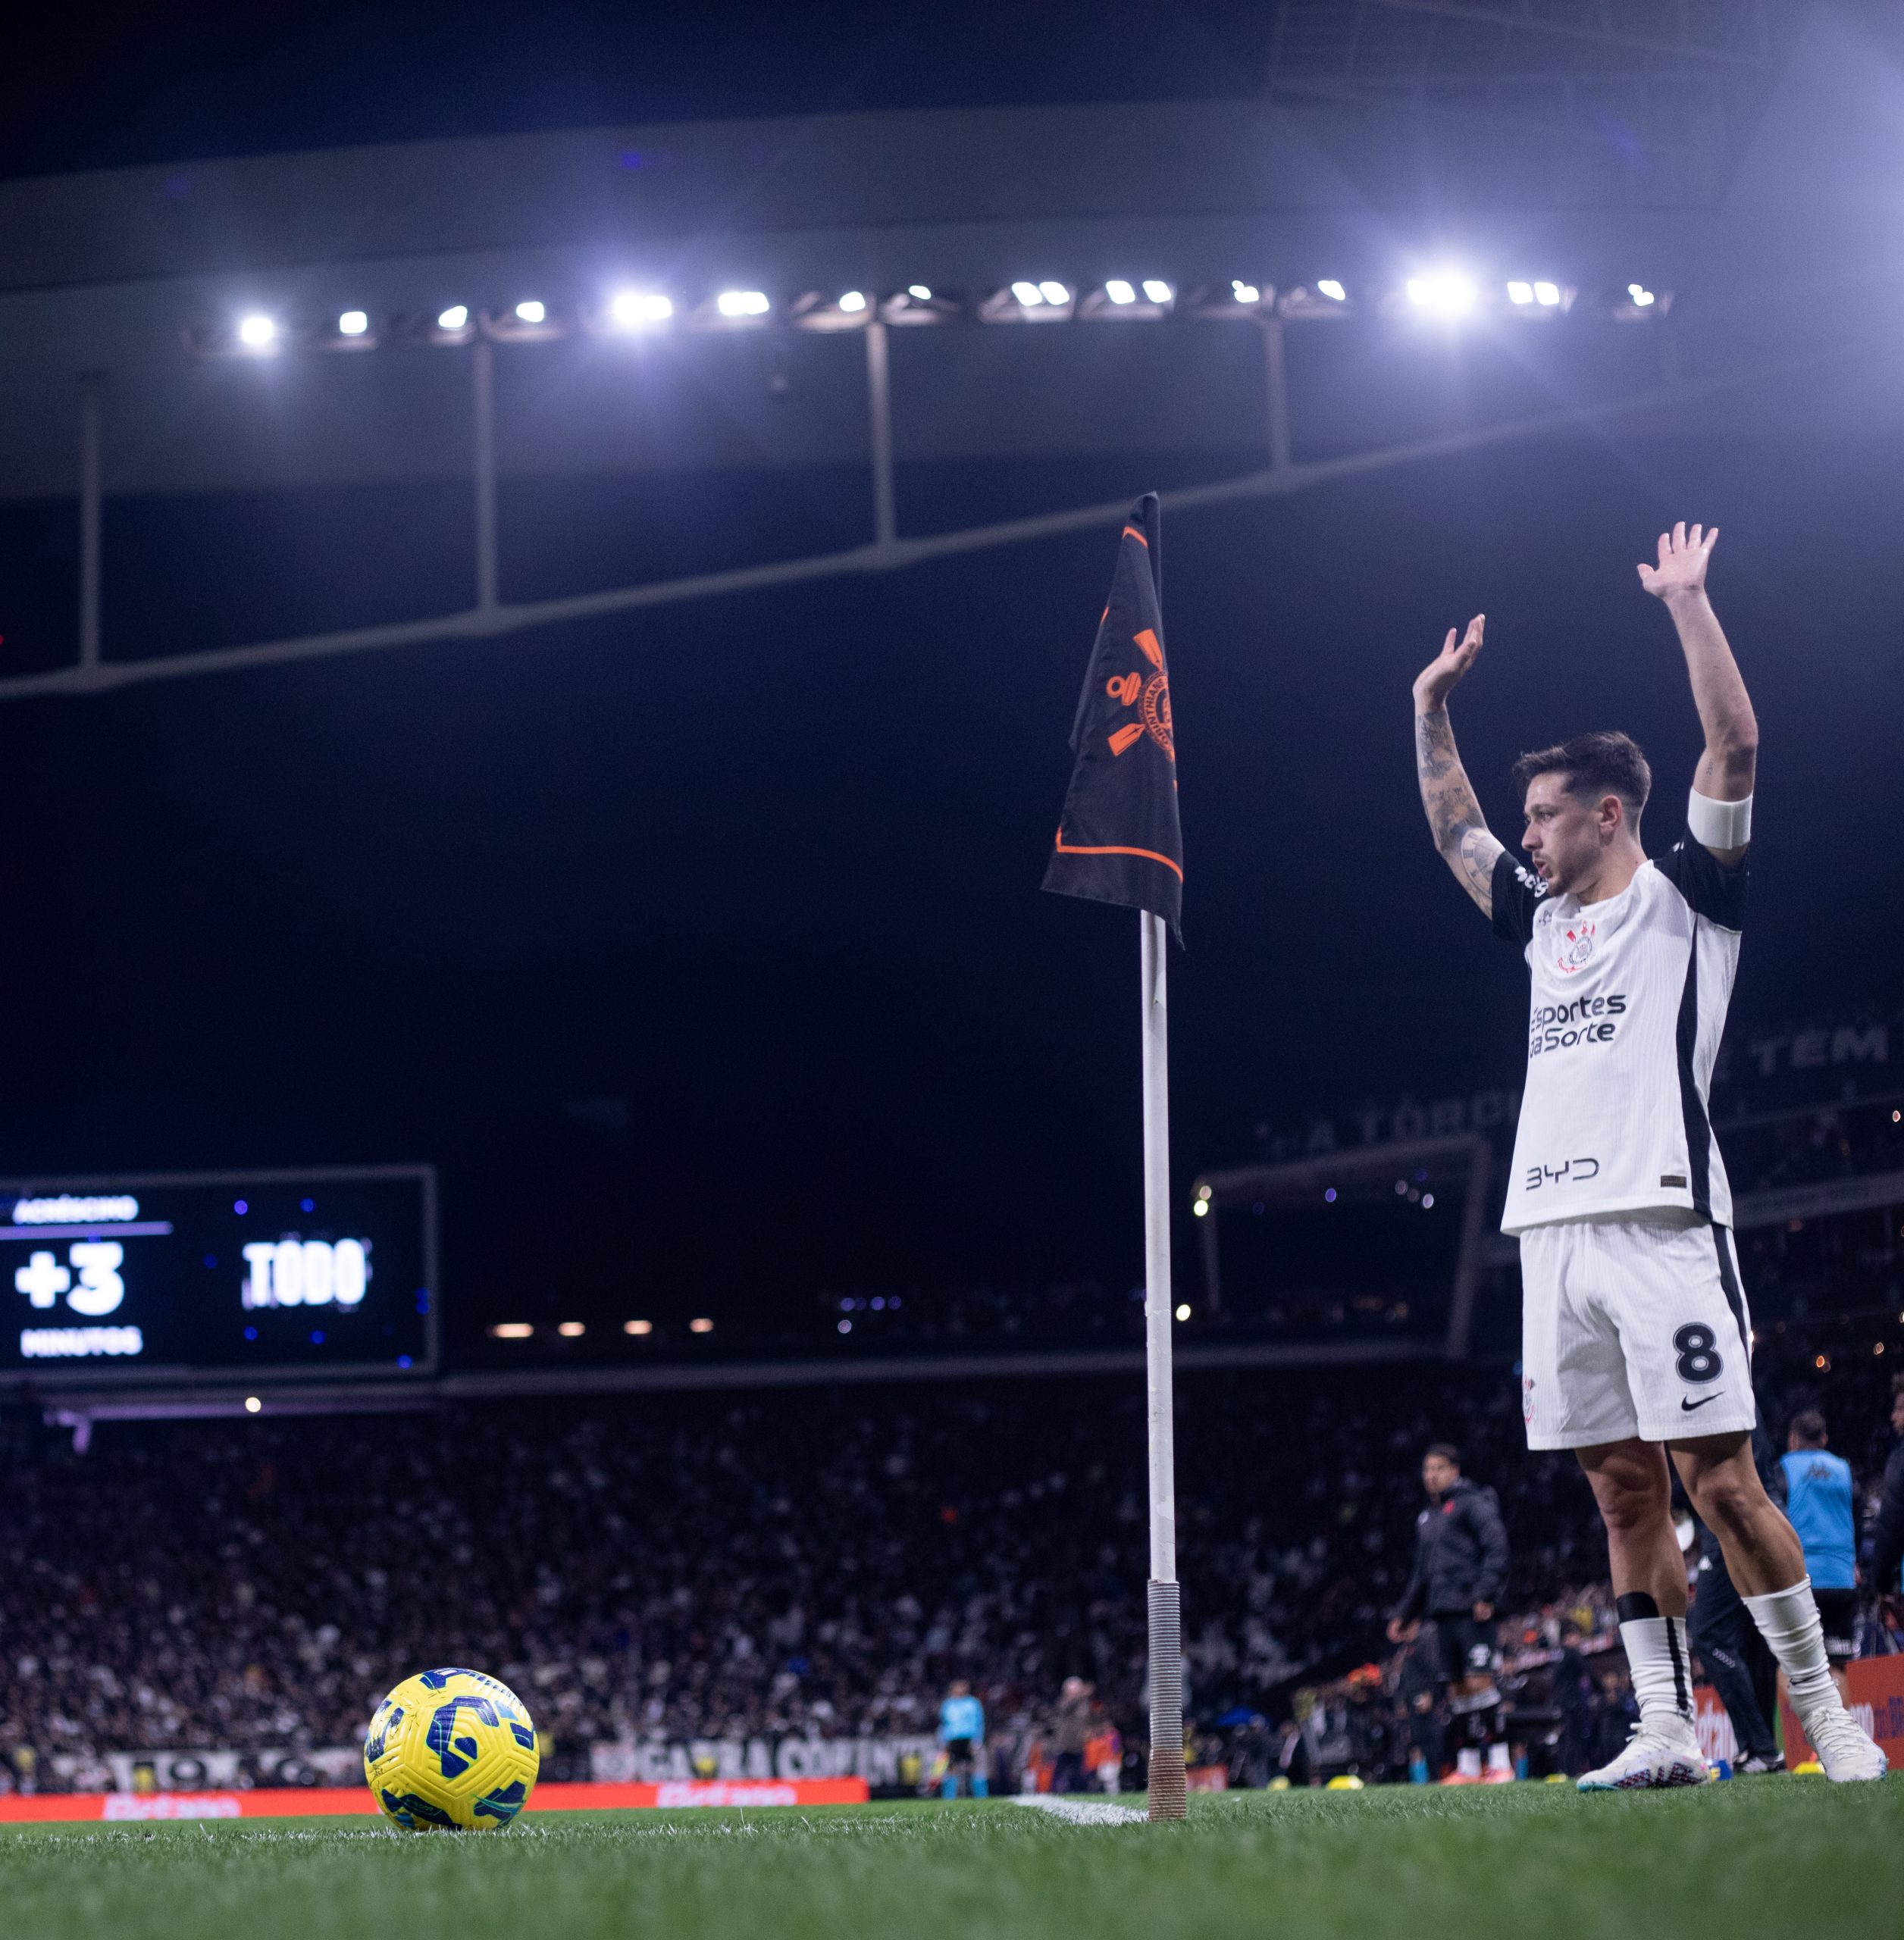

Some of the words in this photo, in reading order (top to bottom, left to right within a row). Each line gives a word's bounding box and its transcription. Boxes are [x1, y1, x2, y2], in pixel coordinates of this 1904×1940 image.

[1526, 1158, 1600, 1191] BYD
[15, 1241, 124, 1316] +3
[242, 1238, 367, 1307] TODO
[1673, 1322, 1724, 1384] 8
